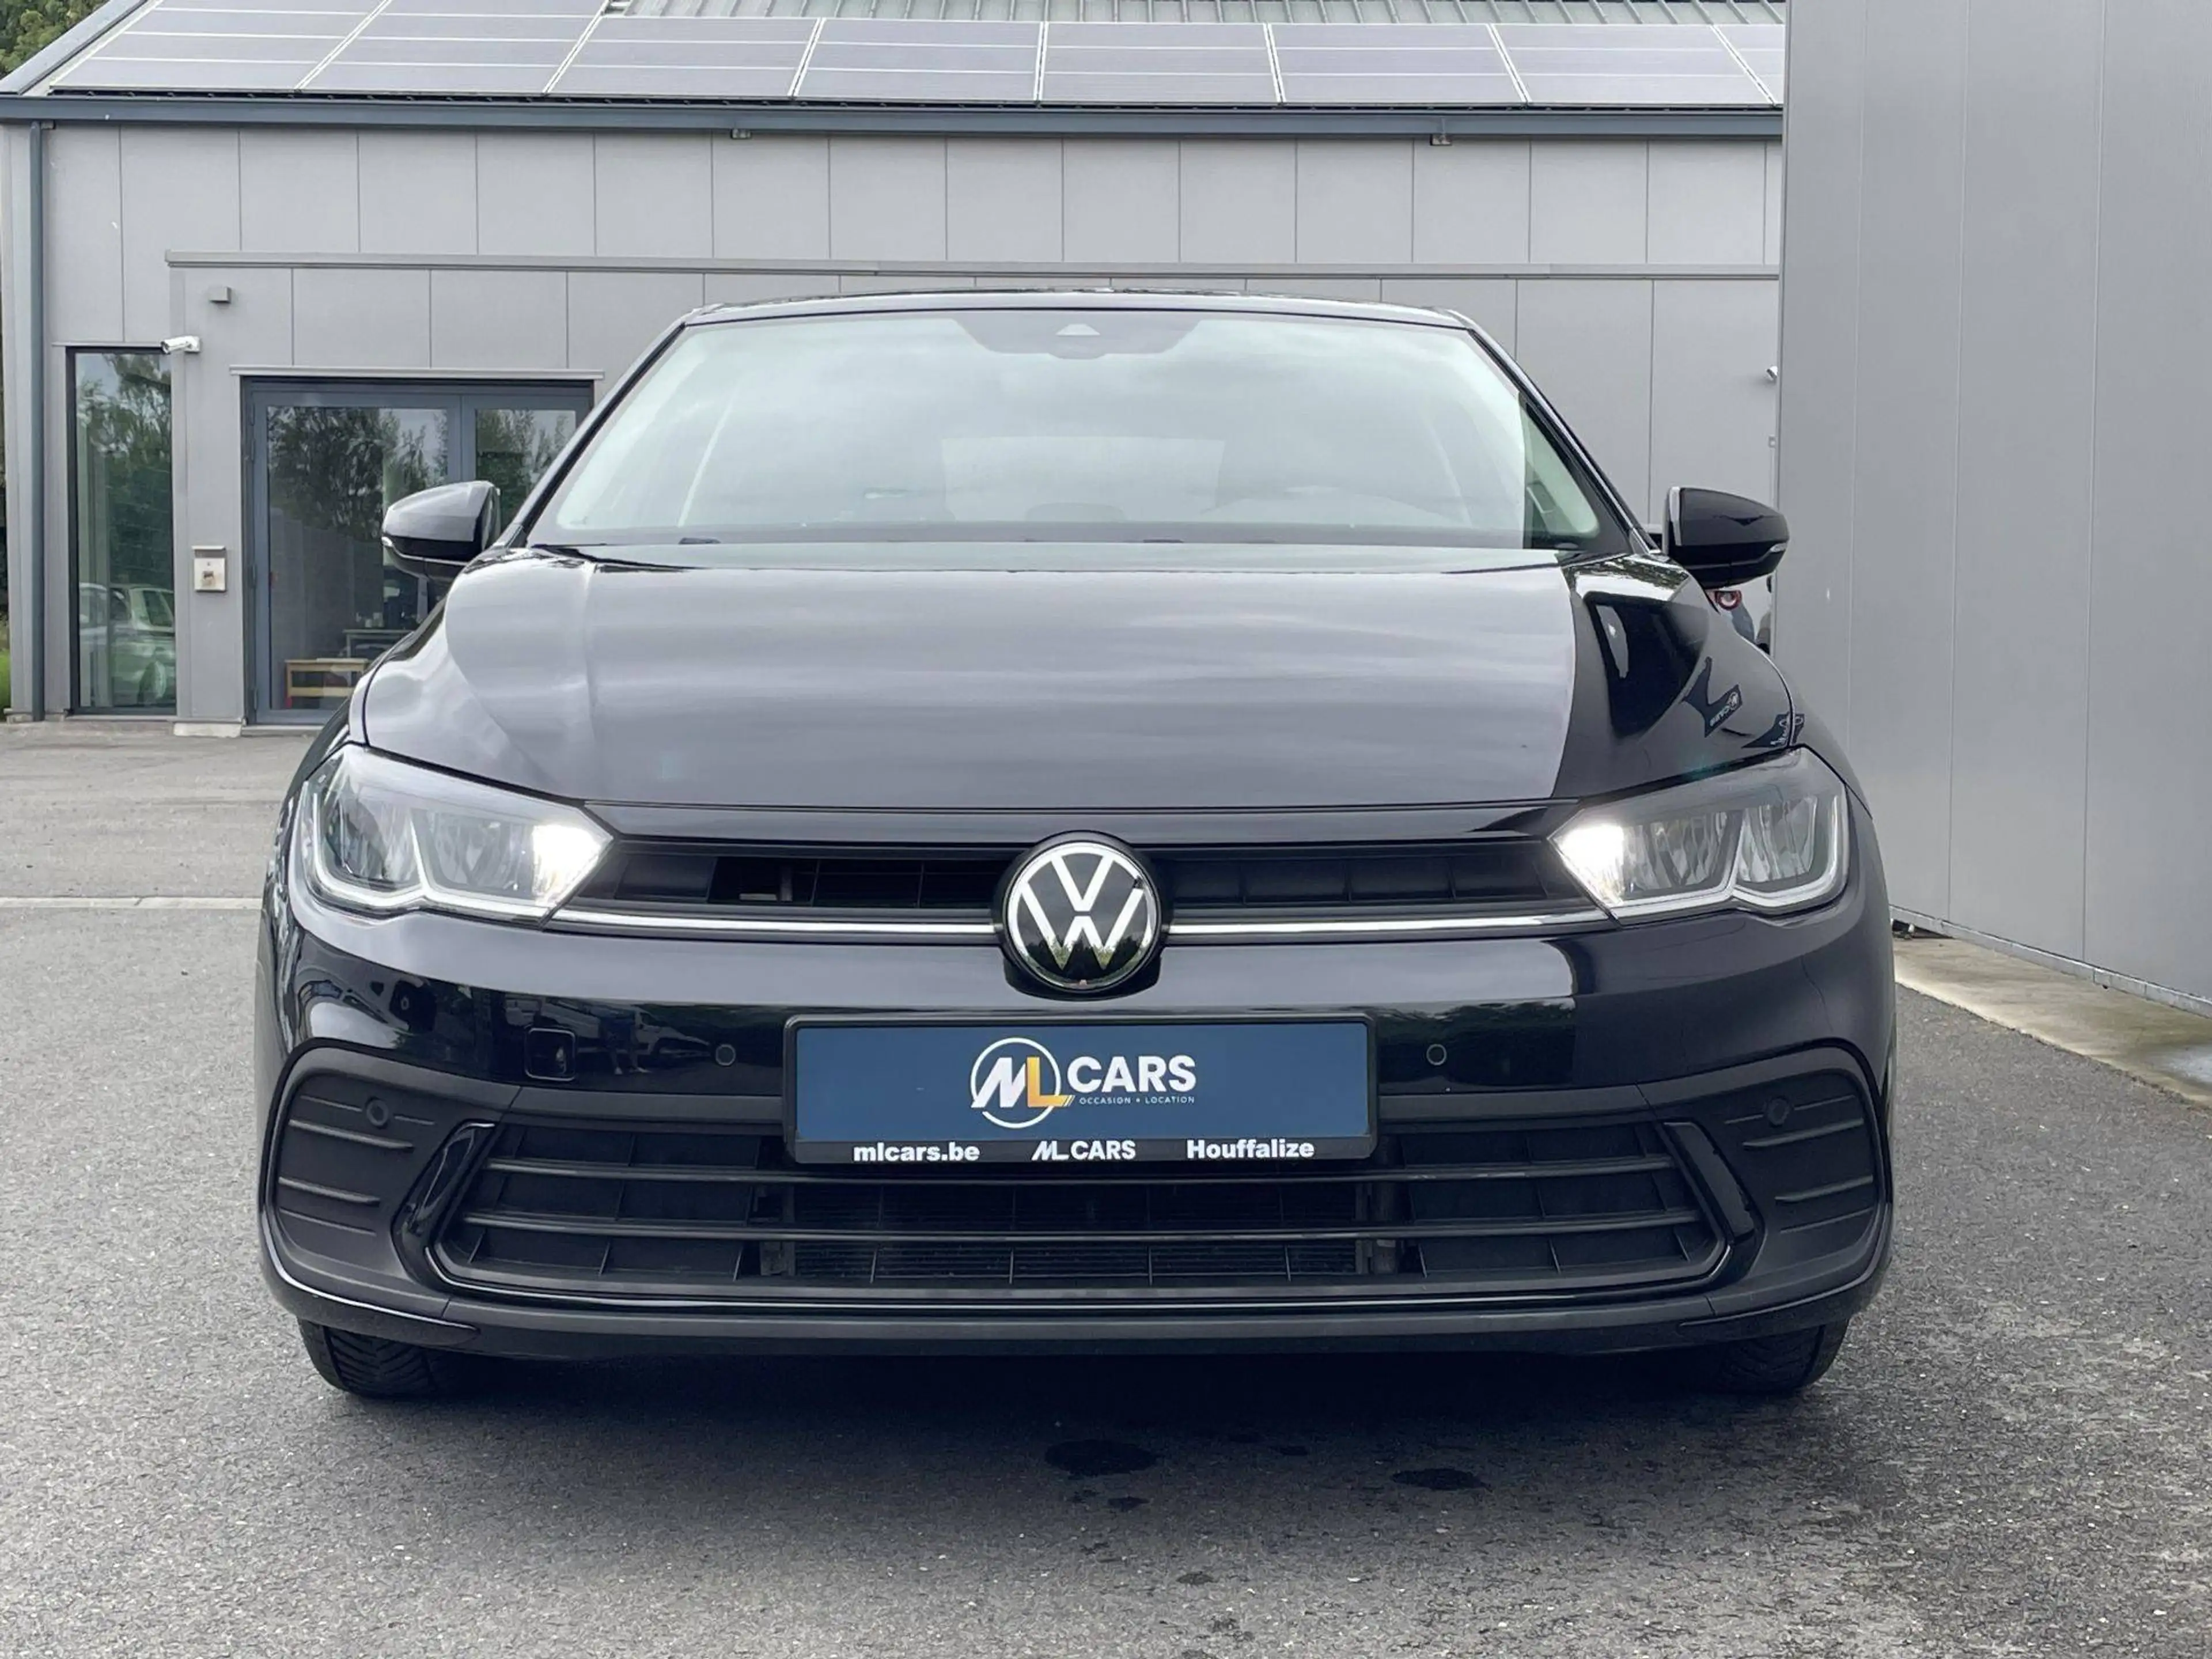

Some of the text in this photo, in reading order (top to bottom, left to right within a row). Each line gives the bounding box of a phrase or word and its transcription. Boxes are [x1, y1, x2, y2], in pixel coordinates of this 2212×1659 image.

[971, 1055, 1196, 1108] ML CARS
[1079, 1096, 1195, 1105] OCCASION LOCATION
[853, 1142, 980, 1162] mlcars.be
[1070, 1140, 1137, 1160] CARS
[1187, 1138, 1316, 1159] Houffalize
